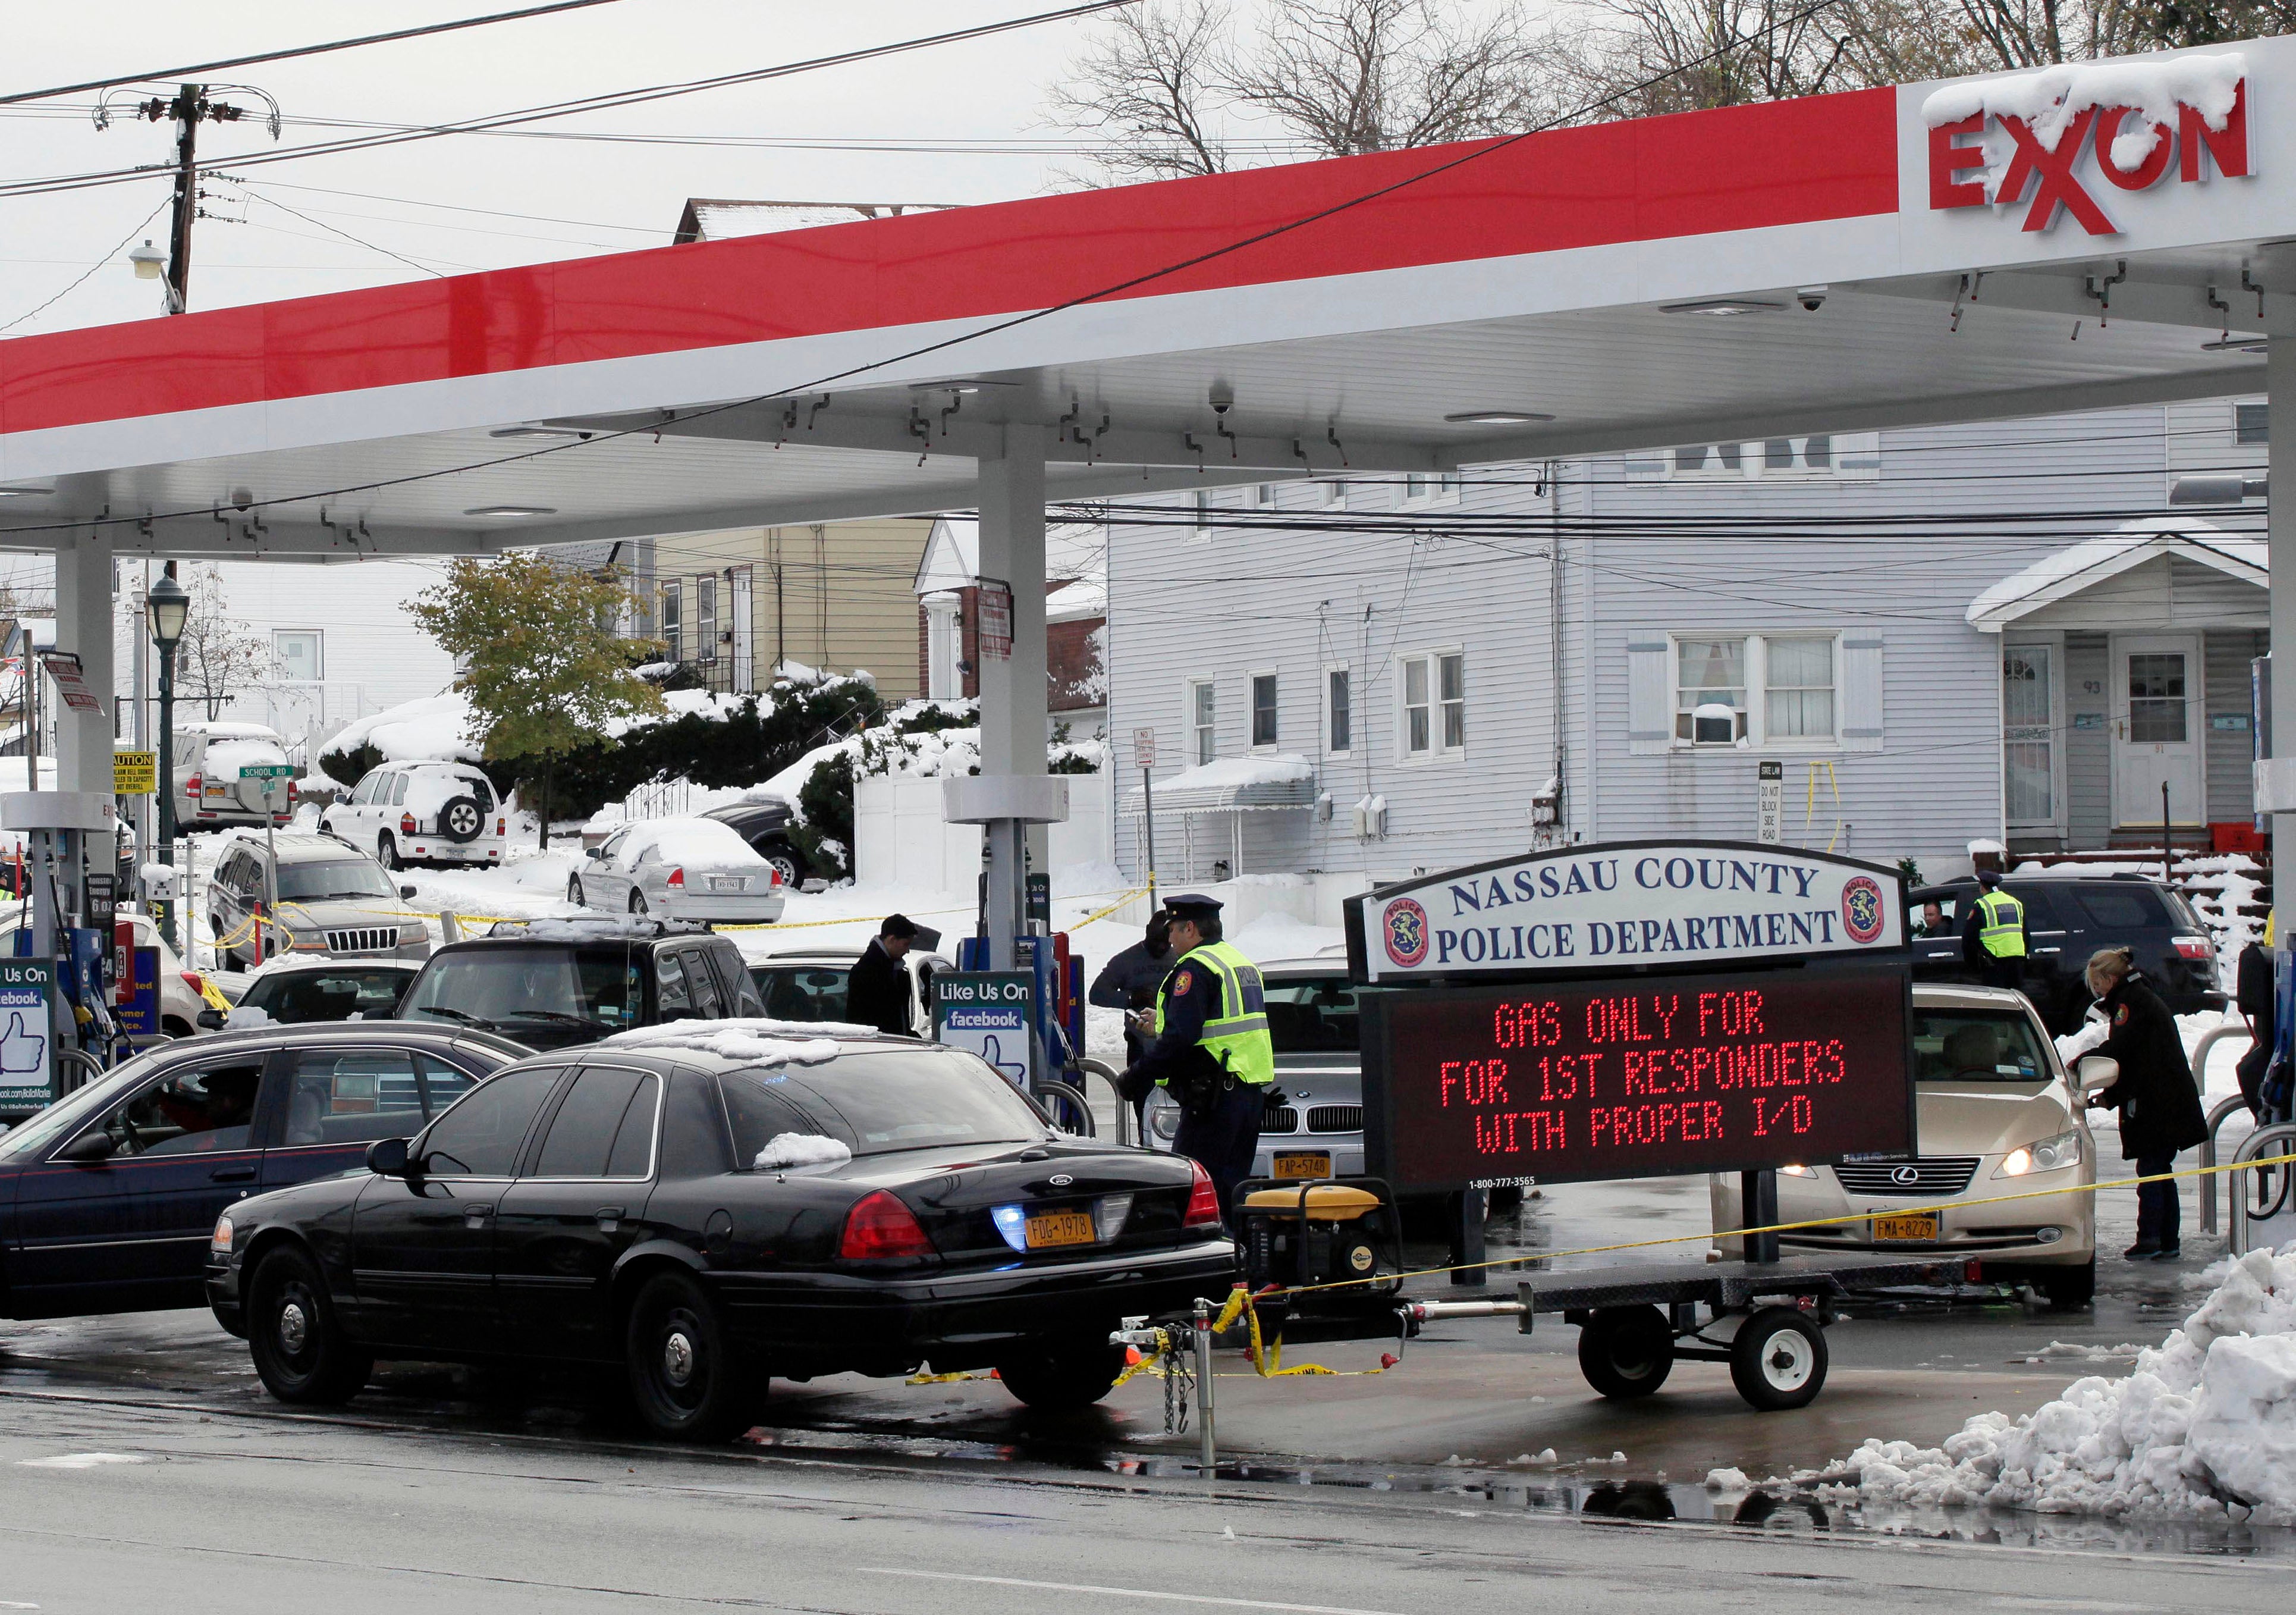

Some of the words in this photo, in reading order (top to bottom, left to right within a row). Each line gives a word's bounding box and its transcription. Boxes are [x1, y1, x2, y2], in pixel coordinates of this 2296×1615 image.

[1928, 75, 2251, 236] EXXON
[2084, 680, 2100, 694] 93
[2155, 742, 2163, 754] 91
[113, 755, 152, 766] AUTION
[245, 769, 272, 777] SCHOOL
[1761, 766, 1772, 775] STATE
[1761, 786, 1769, 797] DO
[1769, 786, 1779, 797] NOT
[1762, 801, 1777, 811] BLOCK
[1764, 816, 1774, 826] SIDE
[1763, 829, 1776, 840] ROAD
[1448, 859, 1619, 917] NASSAU
[1634, 857, 1820, 898] COUNTY
[1846, 880, 1877, 894] POLICE
[1387, 901, 1421, 917] POLICE
[1435, 924, 1575, 963] POLICE
[1587, 910, 1838, 955] DEPARTMENT
[5, 967, 21, 982] Us
[25, 967, 47, 982] On
[0, 991, 38, 1005] ebook
[940, 983, 974, 1001] Like
[979, 983, 998, 1001] Us
[1003, 983, 1028, 1001] On
[951, 1011, 1018, 1027] facebook
[1495, 1002, 1561, 1048] GAS
[1587, 995, 1678, 1043] ONLY
[1699, 990, 1763, 1037] FOR
[1441, 1059, 1508, 1106] FOR
[1538, 1053, 1603, 1100] 1ST
[1625, 1040, 1845, 1095] RESPONDERS
[1476, 1111, 1565, 1153] WITH
[1591, 1100, 1723, 1146] PROPER
[1752, 1095, 1811, 1136] I/D
[1302, 1159, 1326, 1173] 5748
[1469, 1176, 1535, 1190] 1-800-777-3565
[1031, 1219, 1053, 1240] FDG
[1060, 1215, 1087, 1237] 1978
[1878, 1220, 1898, 1237] FMA
[1905, 1220, 1933, 1237] 8229
